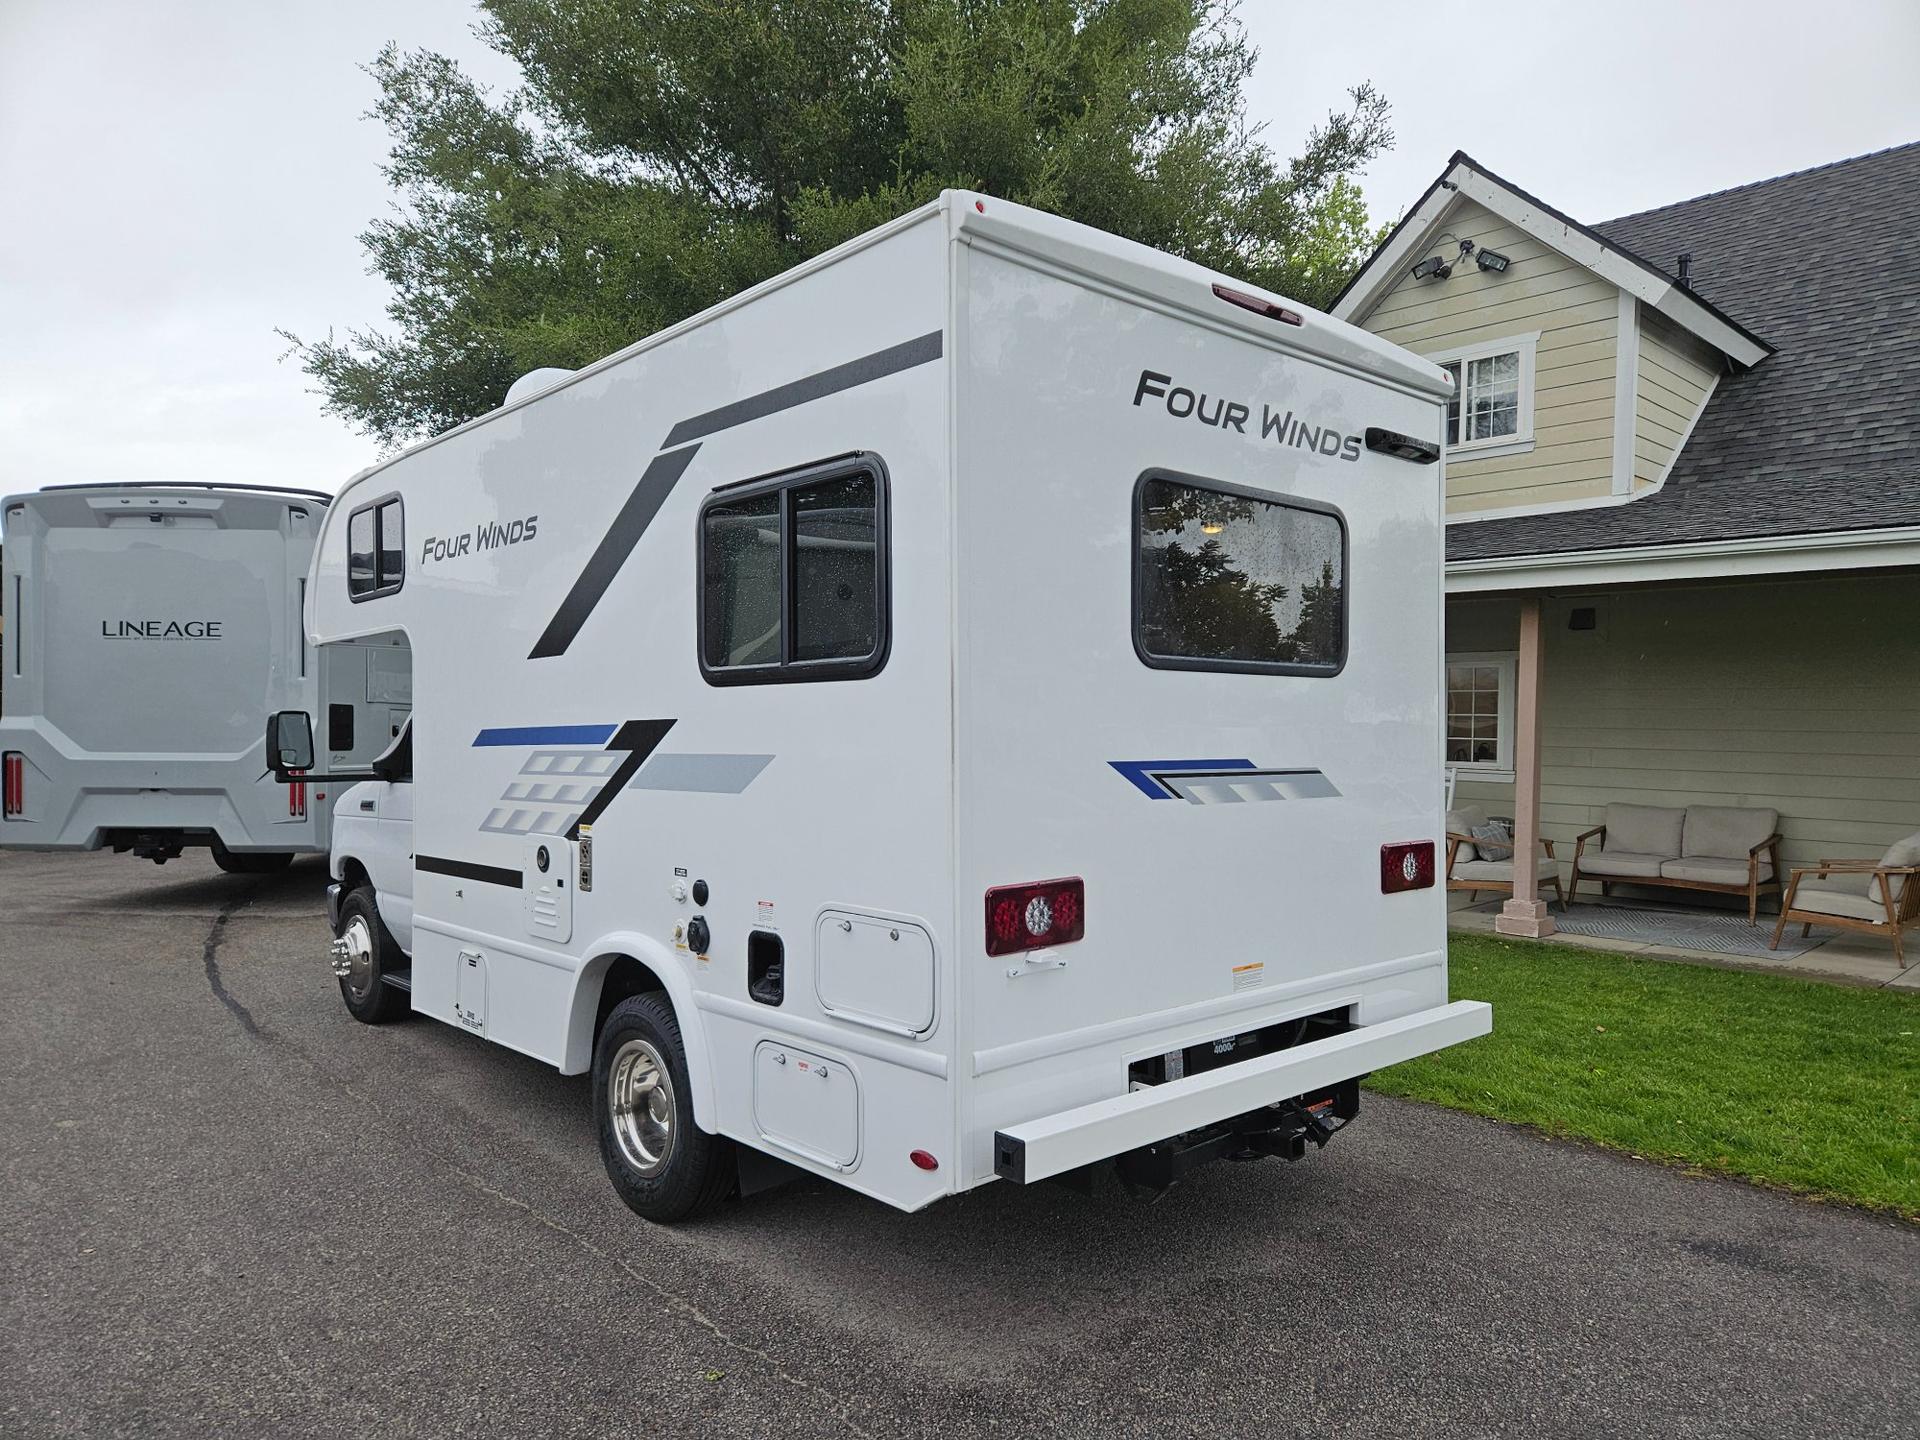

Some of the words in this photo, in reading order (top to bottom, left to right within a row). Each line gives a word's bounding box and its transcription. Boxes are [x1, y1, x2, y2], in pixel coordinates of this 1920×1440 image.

[1133, 369, 1250, 434] FOUR
[1261, 403, 1362, 462] WINDS
[421, 533, 471, 565] FOUR
[476, 515, 538, 552] WINDS
[102, 620, 223, 638] LINEAGE
